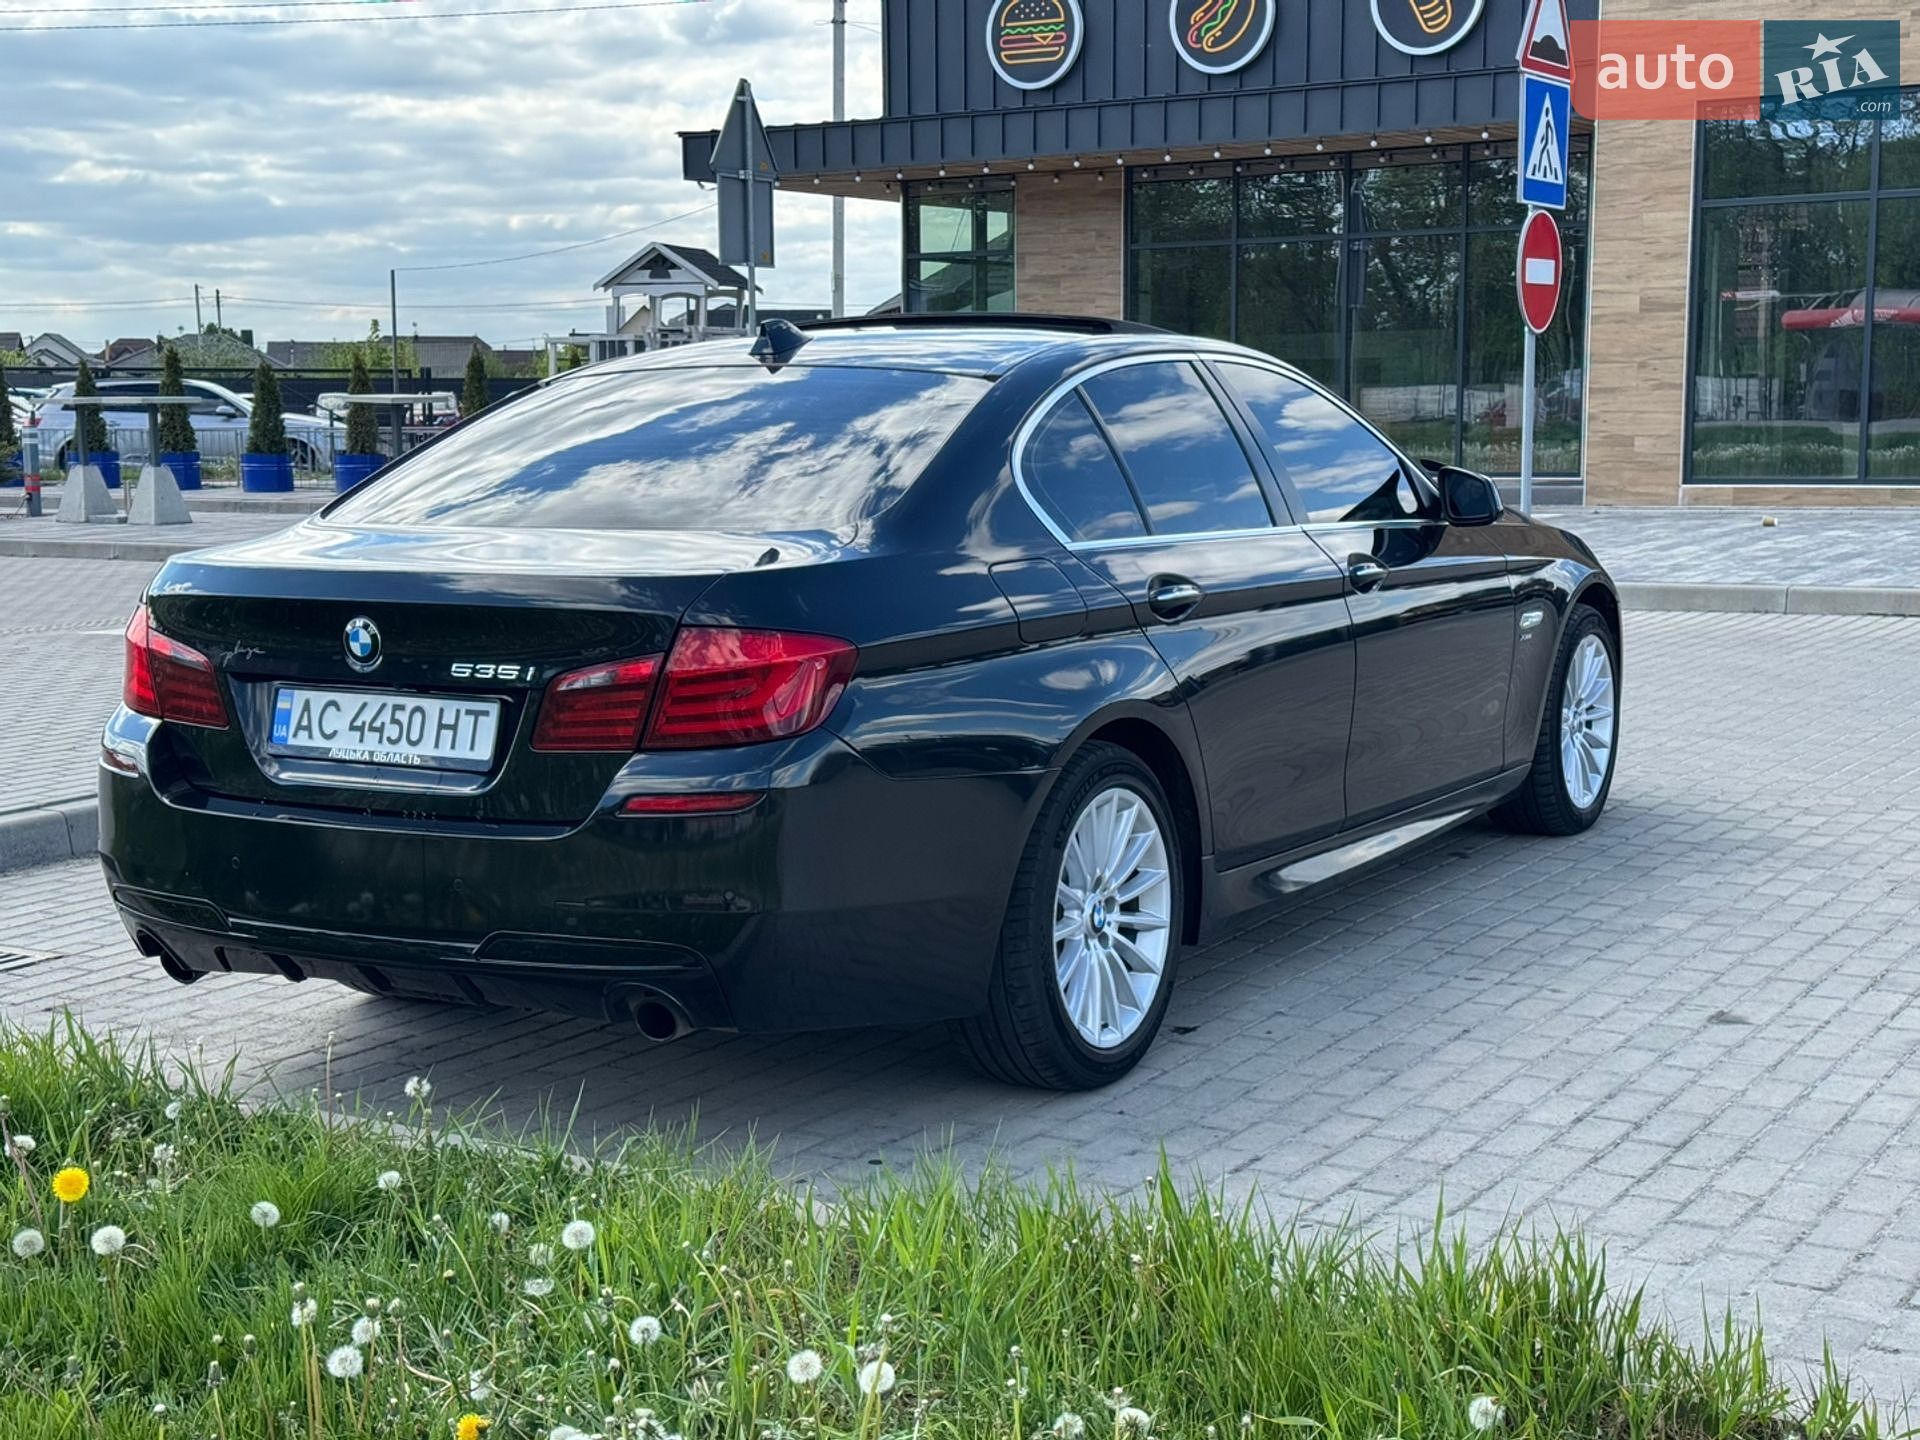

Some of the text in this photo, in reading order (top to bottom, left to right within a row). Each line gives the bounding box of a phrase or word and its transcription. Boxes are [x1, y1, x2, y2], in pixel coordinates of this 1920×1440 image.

[273, 725, 287, 737] UA
[292, 698, 490, 752] AC 4450 HT
[373, 752, 421, 765] ОБЛАСТЬ
